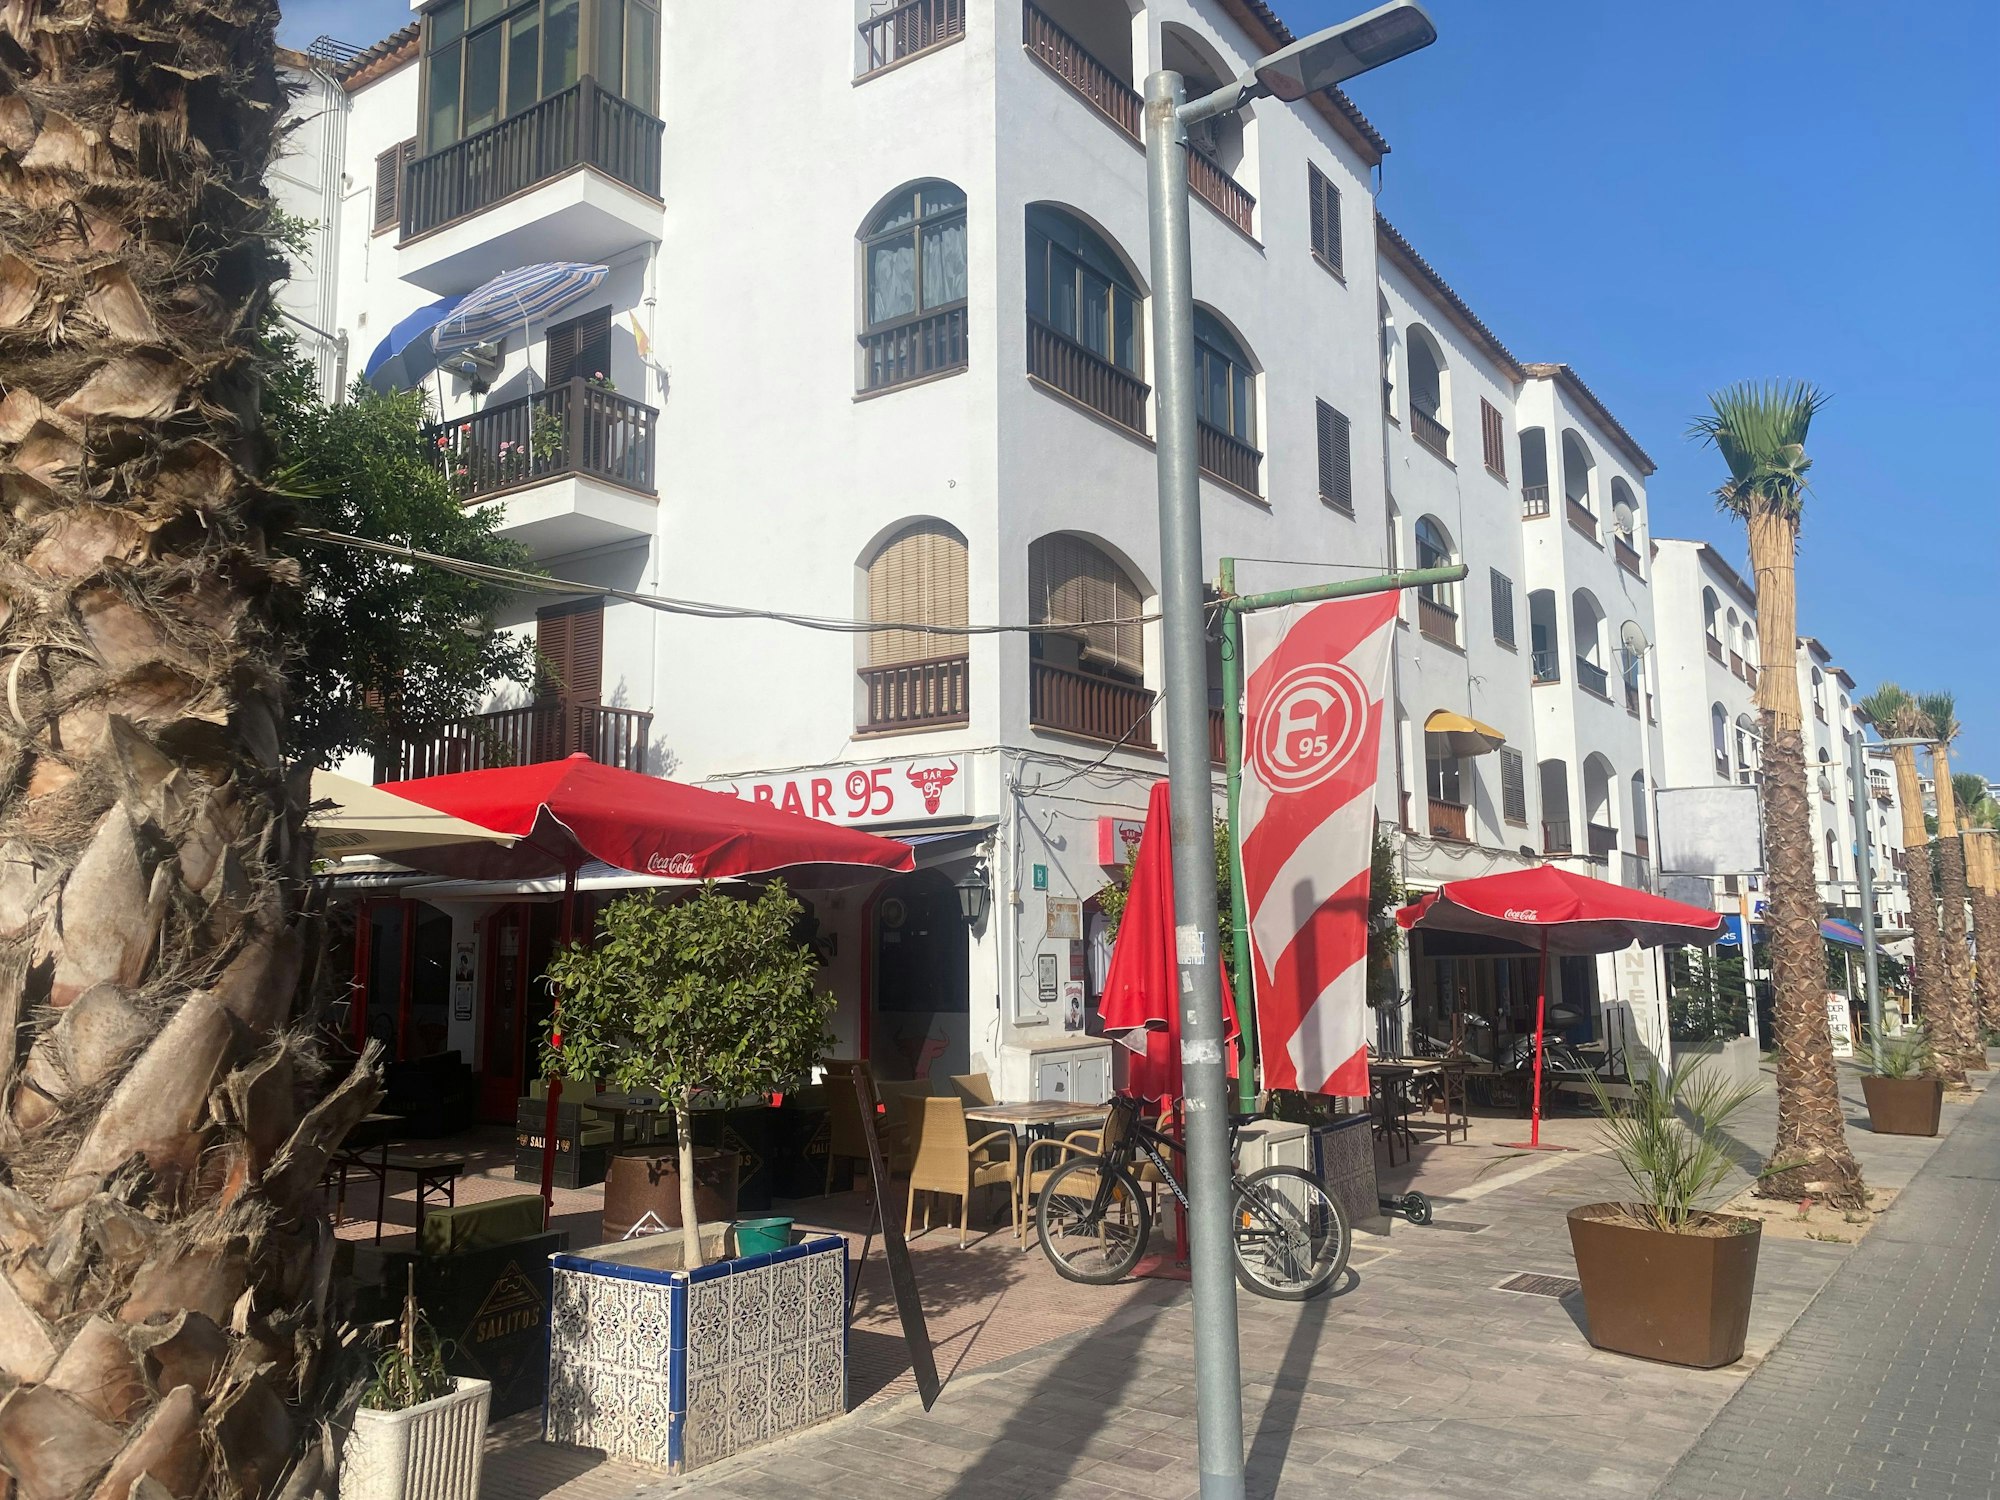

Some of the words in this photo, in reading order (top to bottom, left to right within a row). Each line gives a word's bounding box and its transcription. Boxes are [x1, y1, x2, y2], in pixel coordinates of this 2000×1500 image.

[1298, 734, 1328, 759] 95
[922, 770, 942, 780] BAR
[753, 778, 836, 818] BAR
[845, 767, 894, 818] 95
[923, 781, 941, 799] 95
[647, 851, 697, 874] Coca-Cola
[475, 1304, 540, 1344] SALITOS
